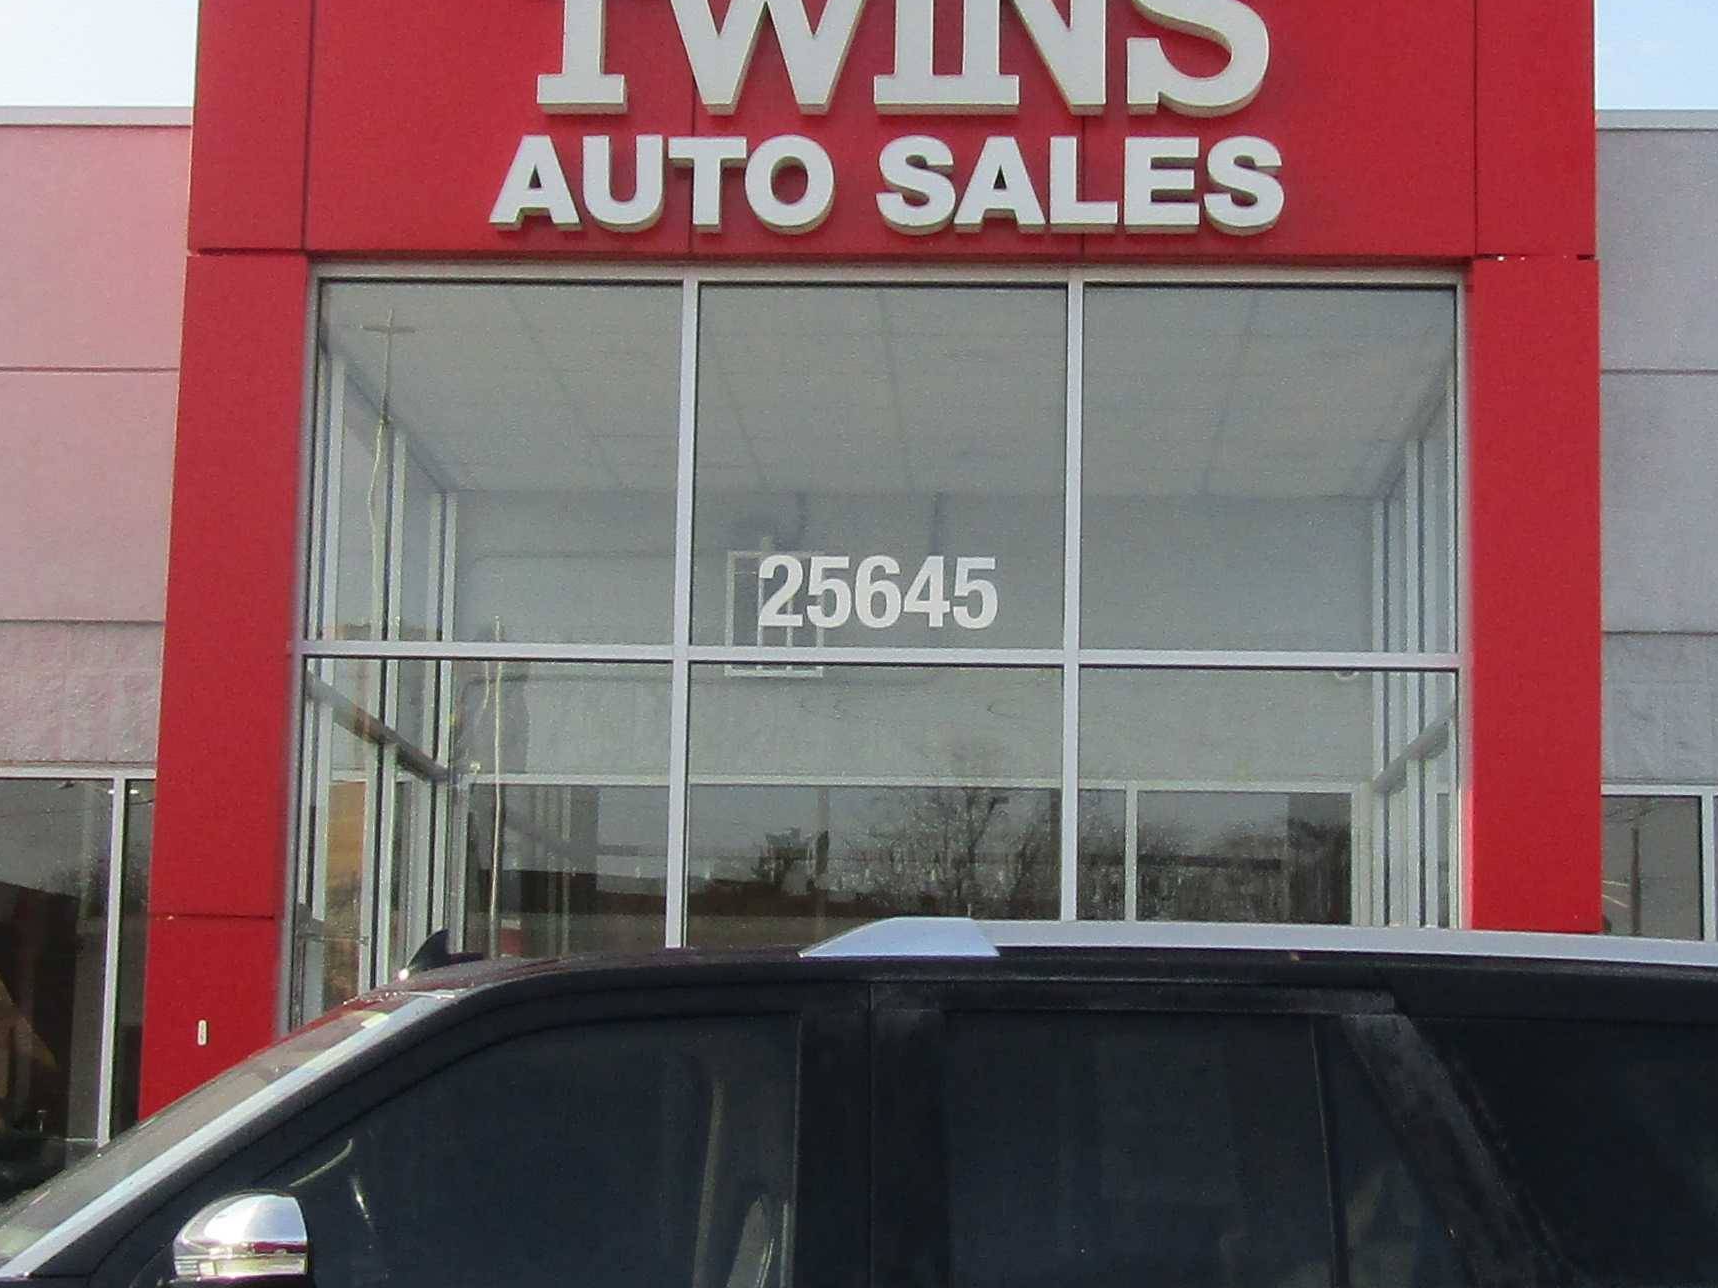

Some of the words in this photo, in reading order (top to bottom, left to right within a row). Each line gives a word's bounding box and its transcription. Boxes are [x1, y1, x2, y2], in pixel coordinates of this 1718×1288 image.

[489, 134, 837, 235] AUTO
[877, 134, 1285, 236] SALES
[757, 553, 1000, 631] 25645
